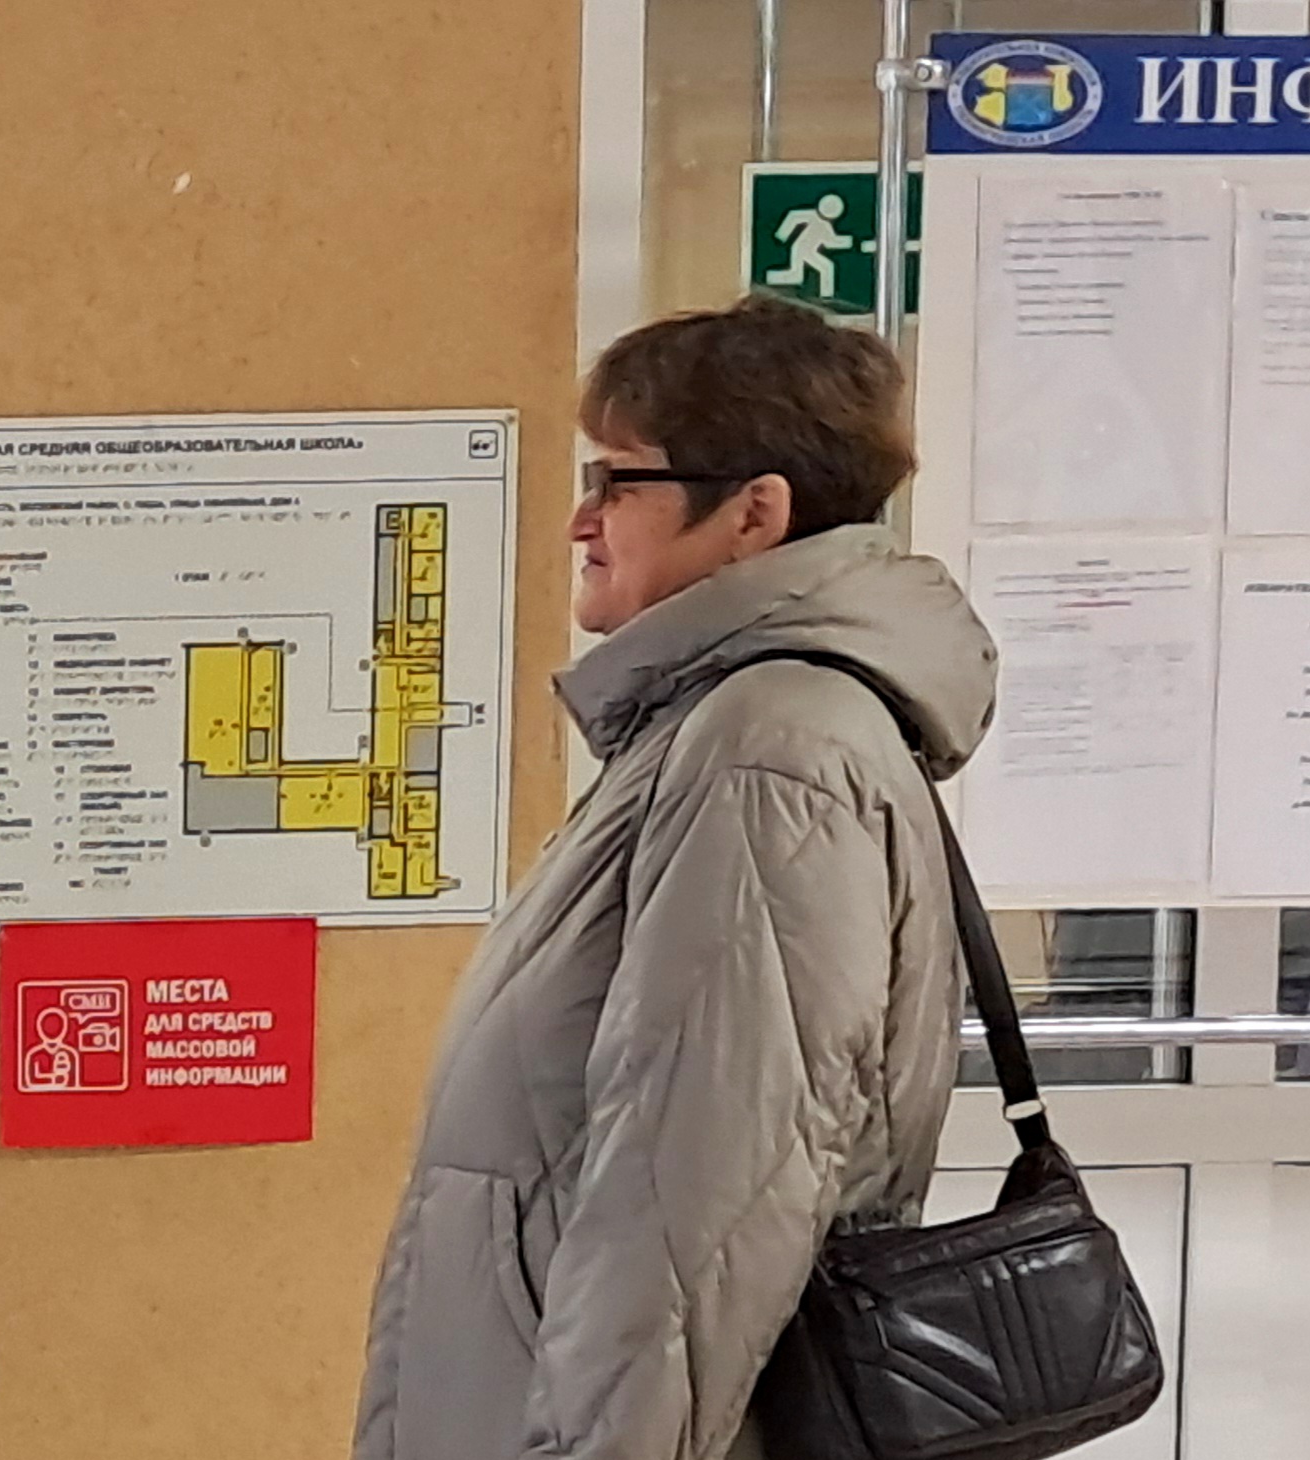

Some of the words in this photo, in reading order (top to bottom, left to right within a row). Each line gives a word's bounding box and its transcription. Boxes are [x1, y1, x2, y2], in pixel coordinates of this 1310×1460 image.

[18, 440, 91, 457] СРЕДНЯЯ
[95, 438, 296, 455] ОБЩЕОБРАЗОВАТЕЛЬНАЯ
[300, 436, 364, 451] ШКОЛА»
[145, 978, 230, 1004] МЕСТА
[144, 1012, 184, 1035] ДЛЯ
[187, 1011, 273, 1032] СРЕДСТВ
[145, 1035, 256, 1059] МАССОВОЙ
[145, 1065, 287, 1087] ИНФОРМАЦИИ
